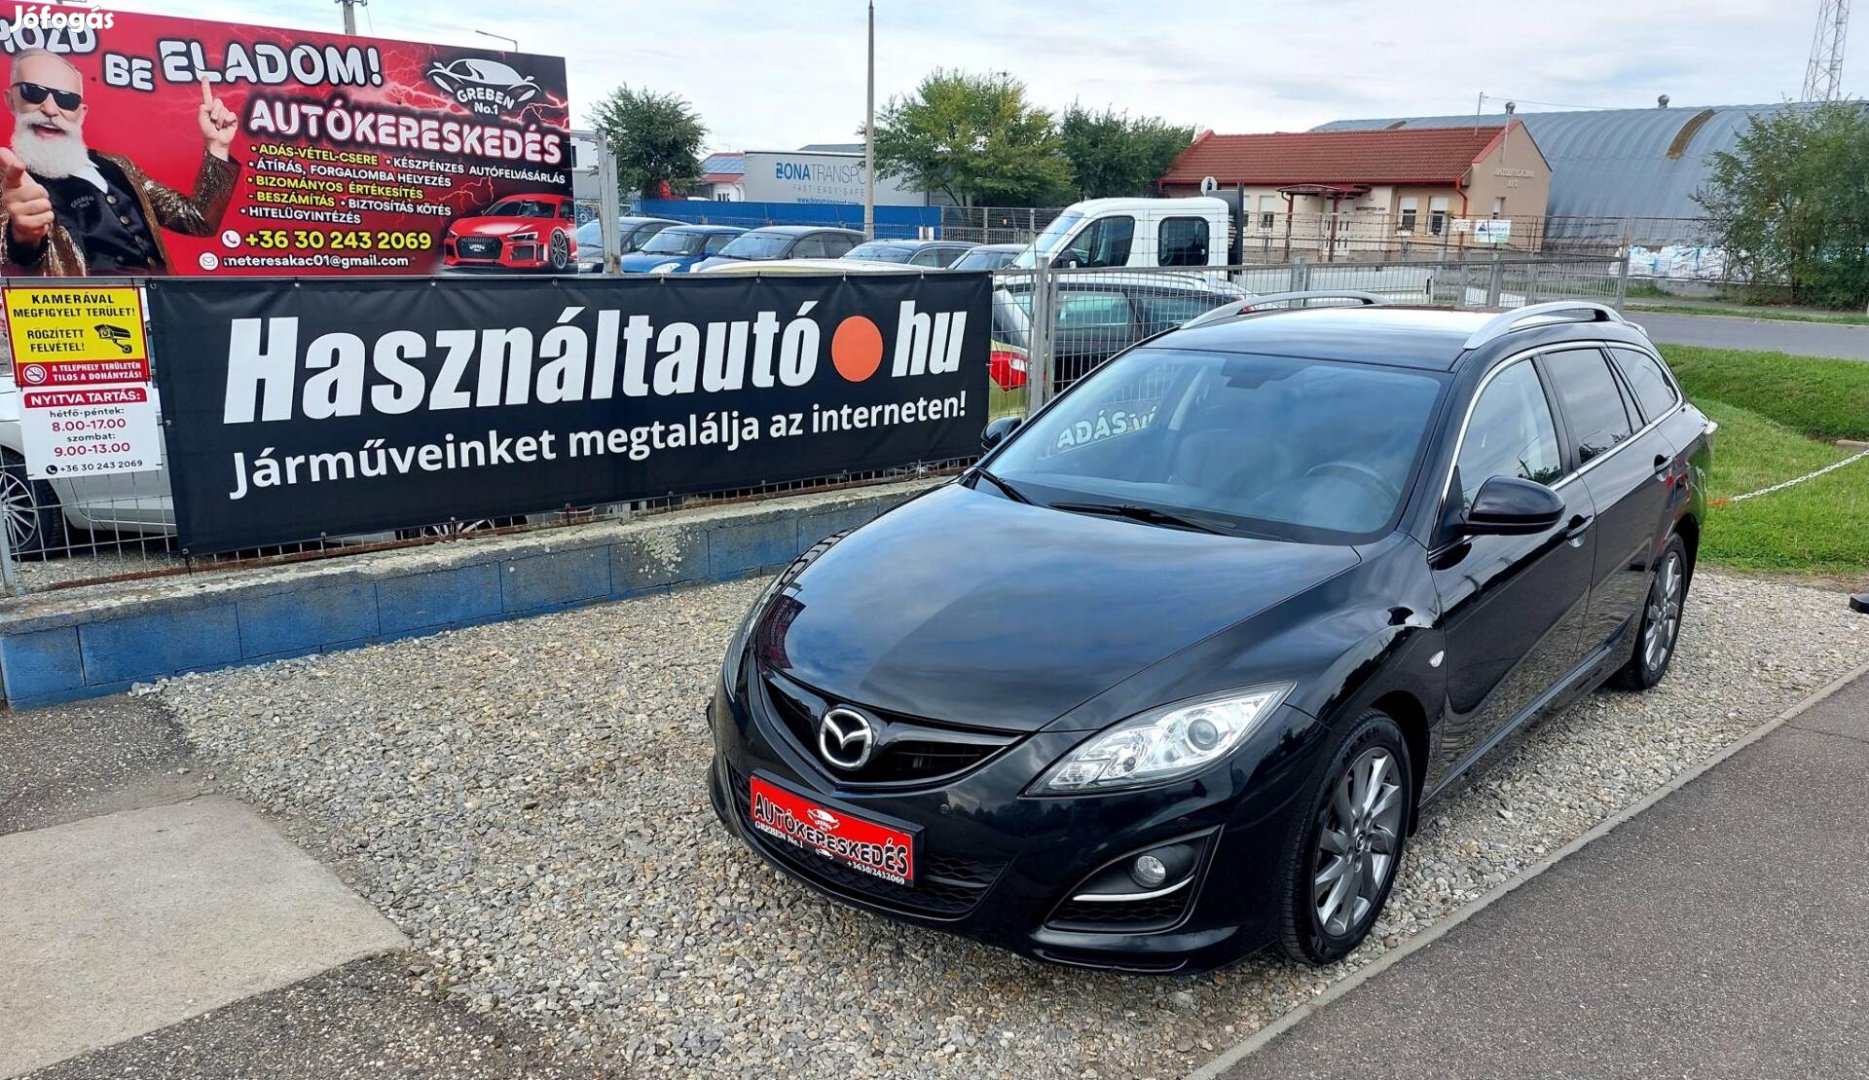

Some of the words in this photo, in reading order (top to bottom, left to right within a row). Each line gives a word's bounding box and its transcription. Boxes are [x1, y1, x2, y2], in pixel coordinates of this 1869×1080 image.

[105, 53, 154, 91] BE
[159, 40, 382, 86] ELADOM!
[457, 87, 515, 109] GREBEN
[474, 102, 498, 115] No.1
[250, 99, 561, 164] AUTÓKERESKEDÉS
[256, 157, 306, 175] ÁTÍRÁS,
[310, 164, 396, 182] FORGALOMBA
[398, 169, 452, 187] HELYEZÉS
[259, 143, 378, 165] ADÁS-VÉTEL-CSERE
[393, 156, 465, 175] KÉSZPÉNZES
[469, 165, 566, 184] AUTÓFELVÁSÁRLÁS
[256, 175, 344, 193] BIZOMÁNYOS
[349, 181, 423, 199] ÉRTÉKESÍTÉS
[256, 190, 335, 207] BESZÁMÍTÁS
[348, 198, 414, 213] BIZTOSÍTÁS
[416, 201, 452, 216] KÖTÉS
[249, 205, 361, 224] HITELÜGYINTÉZÉS
[246, 230, 289, 248] +36
[294, 230, 325, 248] 30
[330, 231, 372, 249] 243
[377, 232, 432, 249] 2069
[32, 292, 115, 304] KAMERÁVAL
[13, 308, 81, 318] MEGFIGYELT
[86, 306, 135, 317] TERÜLET!
[27, 327, 84, 340] RÖGZÍTETT
[30, 342, 85, 352] FELVÉTEL!
[60, 363, 99, 372] TELEPHELY
[222, 300, 820, 426] Használtautó
[890, 301, 968, 377] hu
[53, 373, 78, 381] TILOS
[89, 370, 142, 380] DOHÁNYZÁS!
[31, 393, 85, 406] NYITVA
[86, 388, 141, 402] TARTÁS:
[52, 418, 126, 432] 8.00-17.00
[67, 433, 116, 443] szombat:
[229, 429, 557, 500] Járműveinket
[568, 411, 760, 461] megtalálja
[769, 411, 803, 438] az
[812, 390, 967, 434] interneten!
[54, 442, 131, 457] 9.00-13.00
[60, 463, 79, 473] +36
[81, 462, 94, 472] 30
[97, 461, 116, 471] 243
[118, 459, 143, 469] 2069
[754, 792, 908, 876] AUTÓKERESKEDÉS
